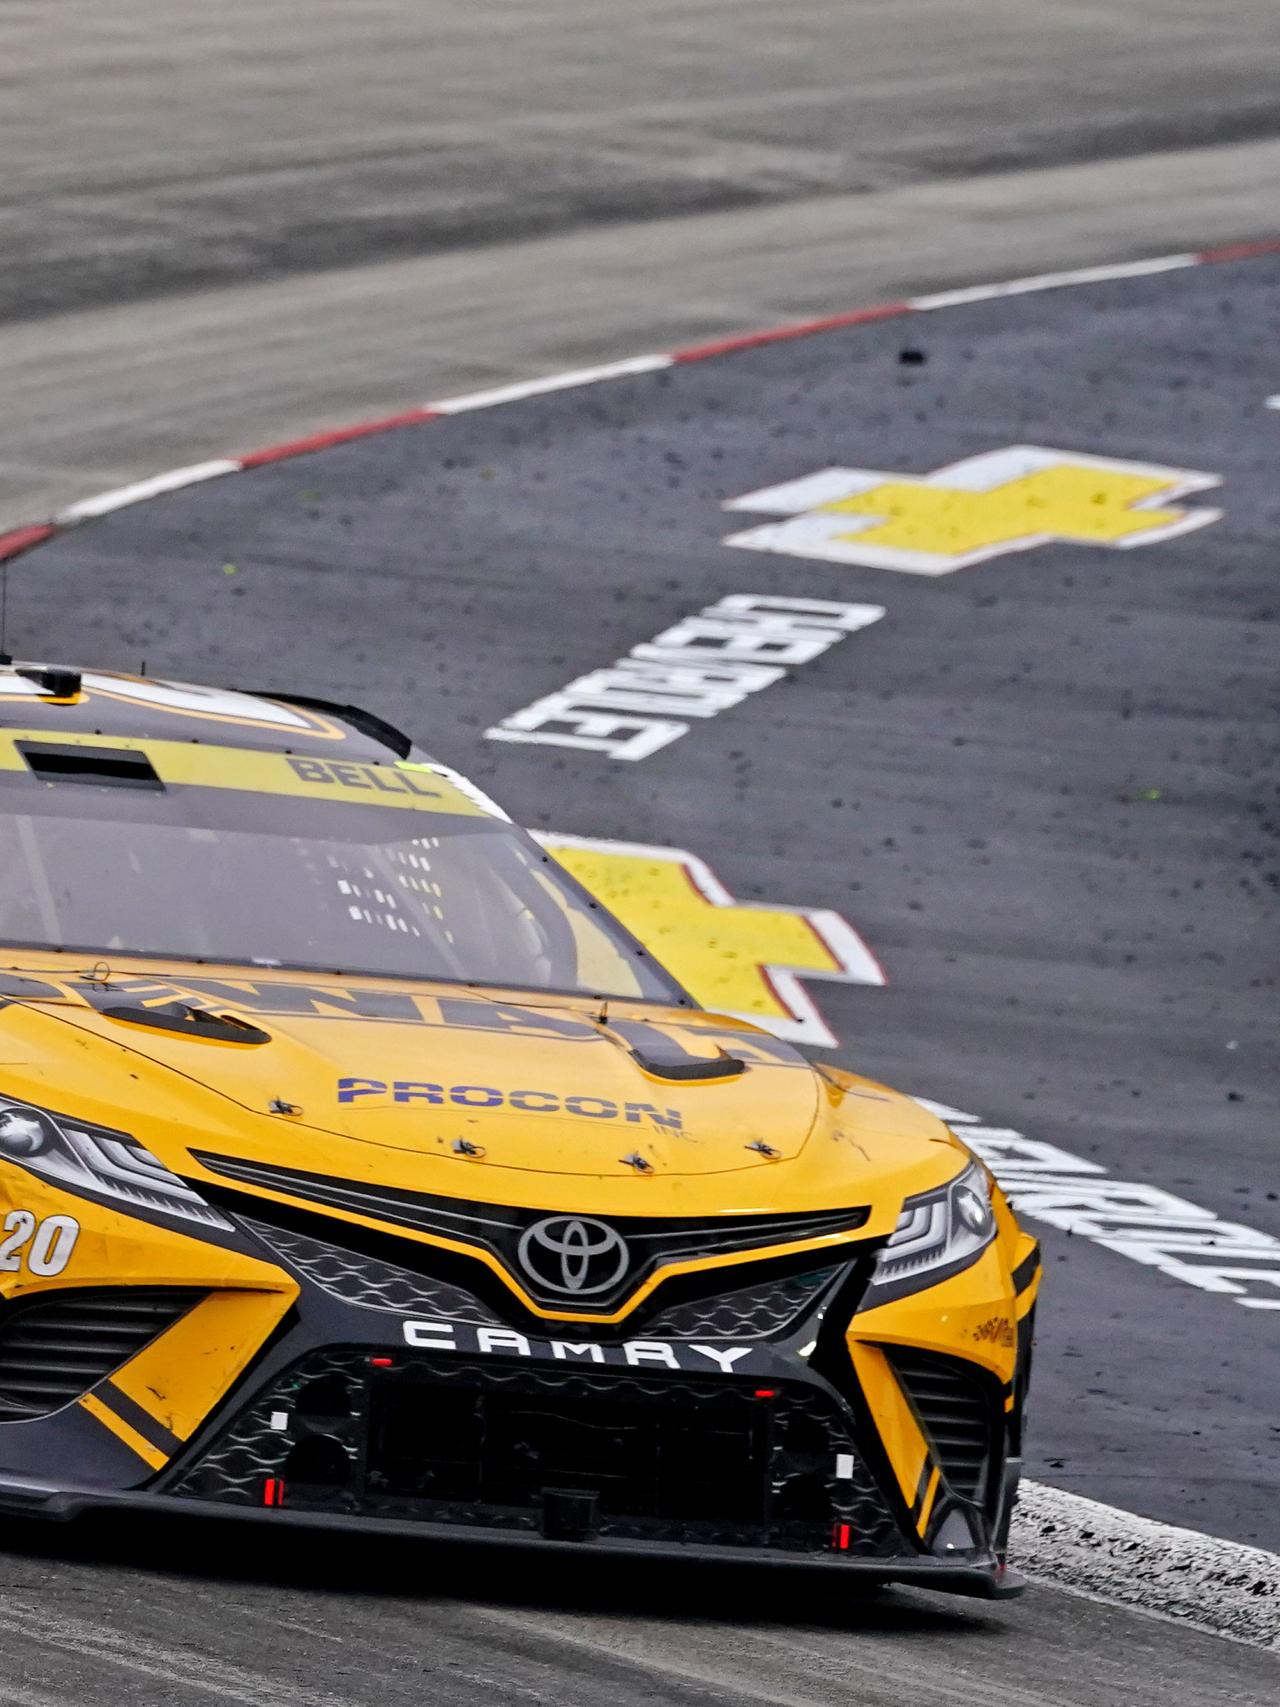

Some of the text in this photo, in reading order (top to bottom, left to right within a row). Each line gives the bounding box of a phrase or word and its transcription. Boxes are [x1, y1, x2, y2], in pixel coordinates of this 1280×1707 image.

[286, 758, 443, 798] BELL
[337, 1077, 683, 1130] PROCON
[402, 1320, 754, 1374] CAMRY
